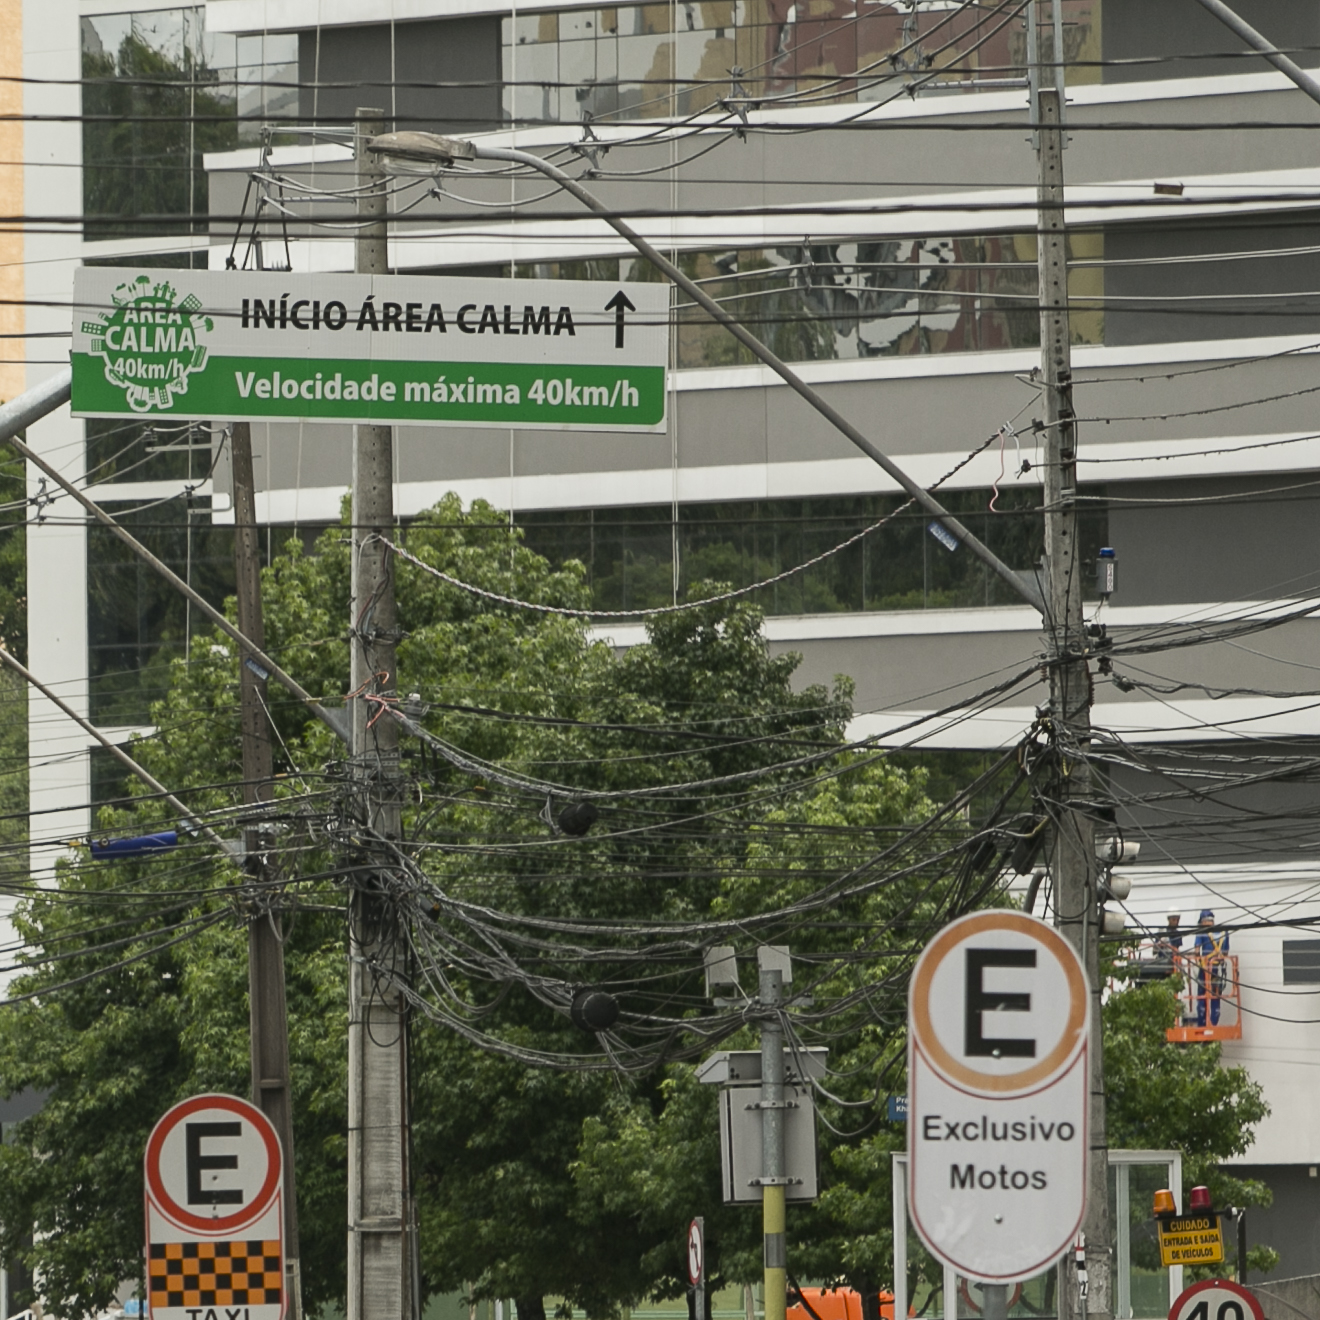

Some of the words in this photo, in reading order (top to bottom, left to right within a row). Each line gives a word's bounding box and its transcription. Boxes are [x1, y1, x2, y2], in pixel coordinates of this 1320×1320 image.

[241, 293, 348, 331] INÍCIO
[357, 294, 447, 334] ÁREA
[457, 304, 576, 337] CALMA
[105, 326, 195, 353] CALMA
[114, 358, 184, 380] 40km/h
[236, 371, 395, 402] Velocidade
[404, 376, 520, 405] máxima
[529, 379, 640, 408] 40km/h
[964, 948, 1037, 1058] E
[922, 1115, 1075, 1142] Exclusivo
[186, 1121, 243, 1205] E
[950, 1164, 1047, 1190] Motos
[1170, 1219, 1210, 1232] CUIDADO
[1163, 1235, 1193, 1247] ENTRADA
[1194, 1234, 1199, 1245] E
[1200, 1232, 1219, 1245] SAÍDA
[1171, 1249, 1180, 1260] DE
[1181, 1247, 1214, 1259] VEÍCULOS
